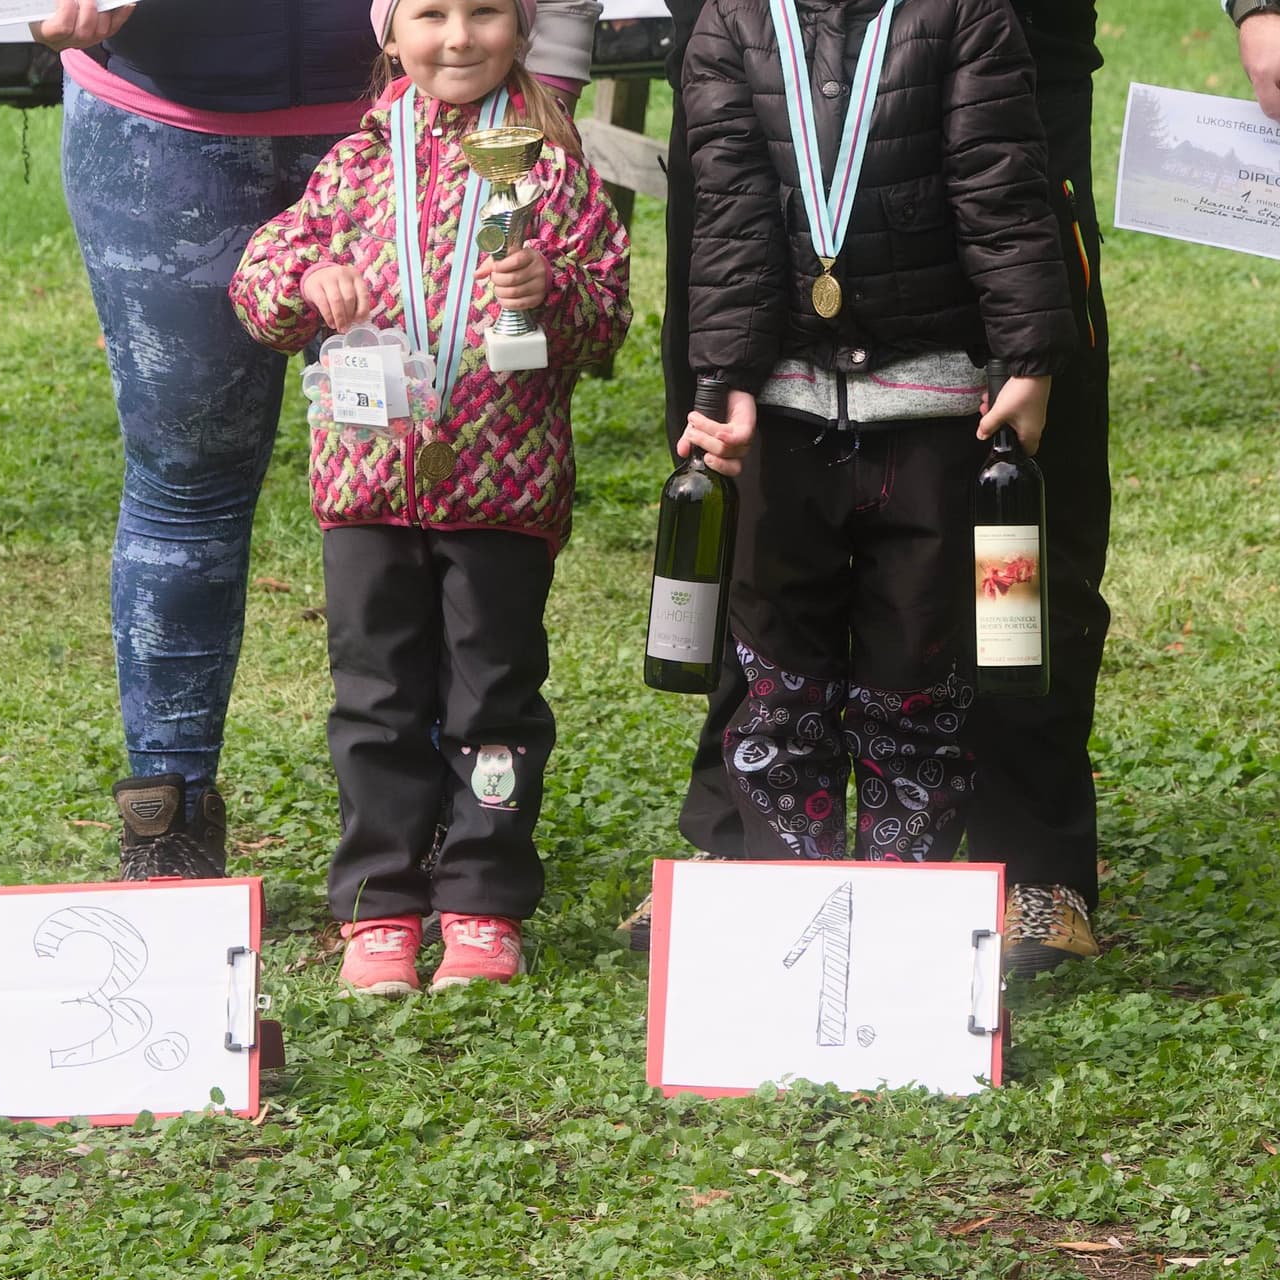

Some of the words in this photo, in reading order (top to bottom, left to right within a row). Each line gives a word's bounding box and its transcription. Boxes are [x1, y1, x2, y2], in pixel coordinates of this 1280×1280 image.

[1196, 114, 1274, 137] LUKOSTŘELBA
[33, 905, 191, 1072] 3.
[782, 880, 878, 1048] 1.
